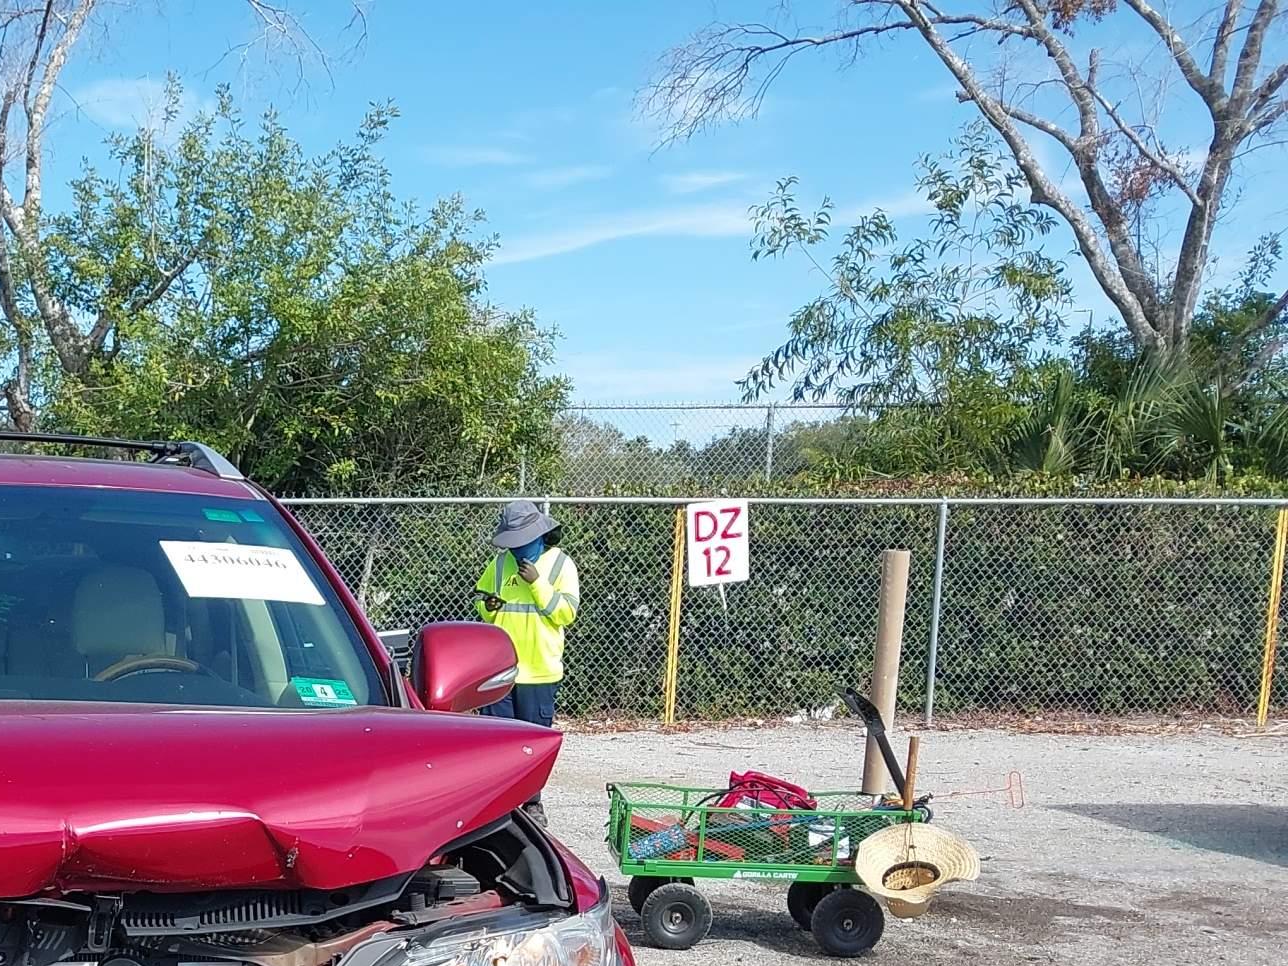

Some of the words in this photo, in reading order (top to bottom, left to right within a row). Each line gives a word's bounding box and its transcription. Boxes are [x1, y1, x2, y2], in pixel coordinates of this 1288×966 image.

[694, 506, 743, 542] DZ
[183, 553, 288, 569] 44306046
[702, 545, 732, 577] 12
[742, 871, 772, 879] GORILLA
